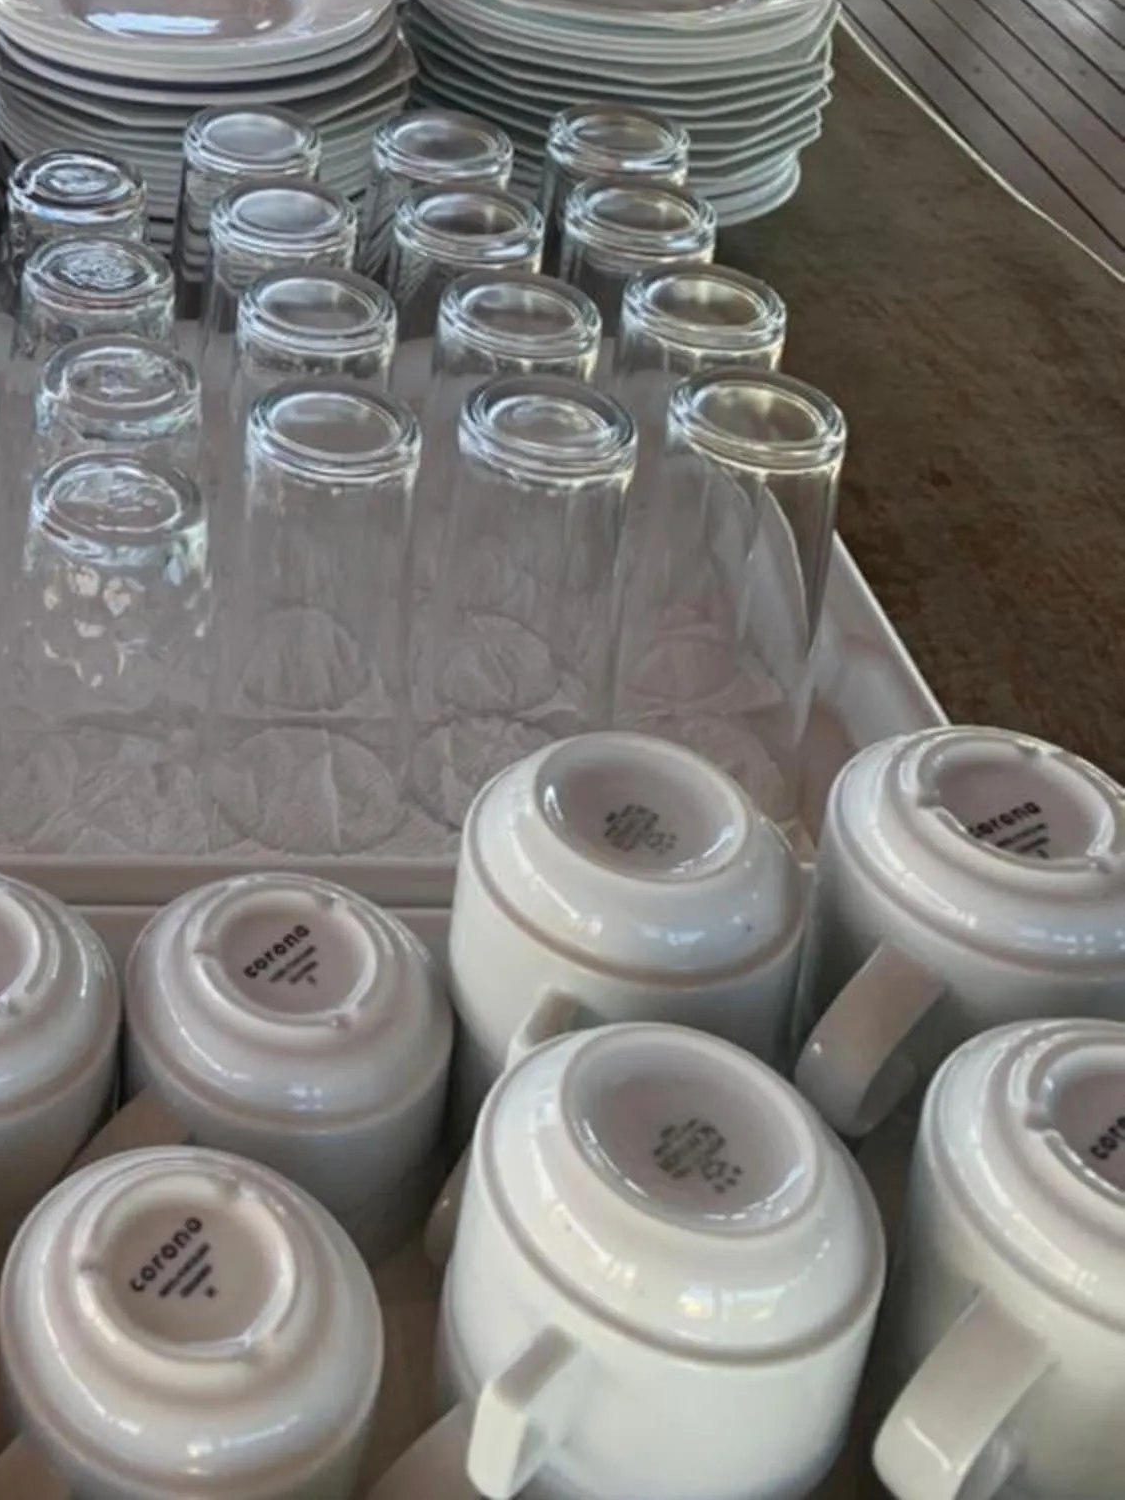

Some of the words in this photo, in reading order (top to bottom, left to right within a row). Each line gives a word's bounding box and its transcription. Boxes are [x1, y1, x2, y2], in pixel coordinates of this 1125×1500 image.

[243, 924, 310, 978] corona
[1090, 1117, 1125, 1160] cor
[129, 1216, 203, 1292] corona
